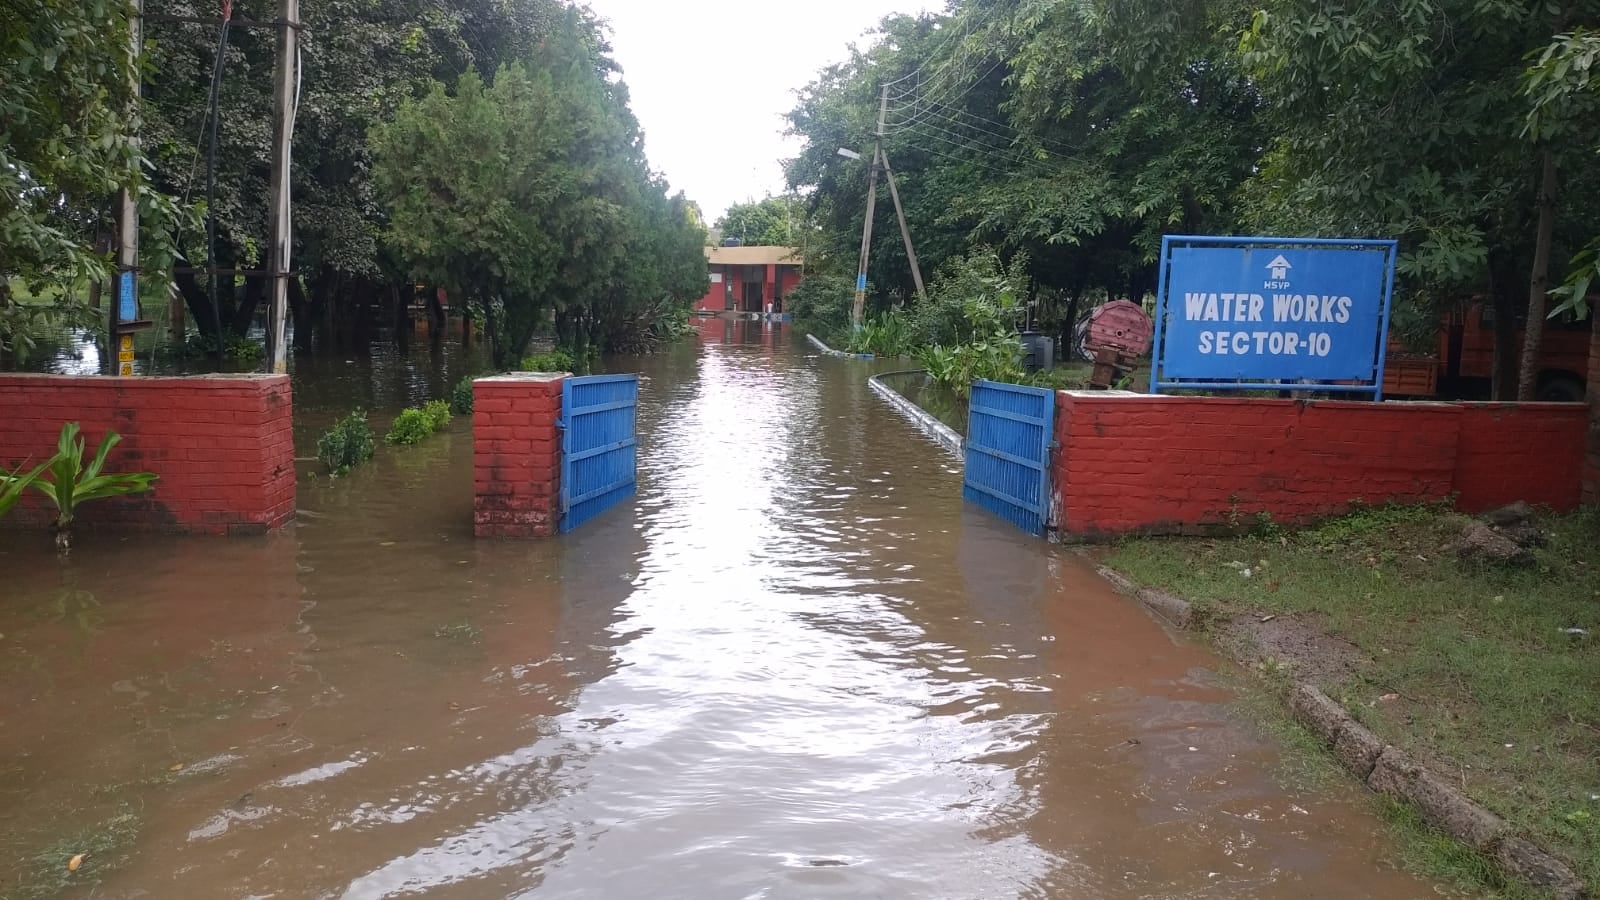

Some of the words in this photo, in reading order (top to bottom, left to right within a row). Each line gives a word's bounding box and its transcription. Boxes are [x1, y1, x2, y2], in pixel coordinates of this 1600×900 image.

[1263, 281, 1290, 290] HSVP
[1185, 293, 1264, 322] WATER
[1273, 294, 1352, 323] WORKS
[1199, 331, 1331, 357] SECTOR-10
